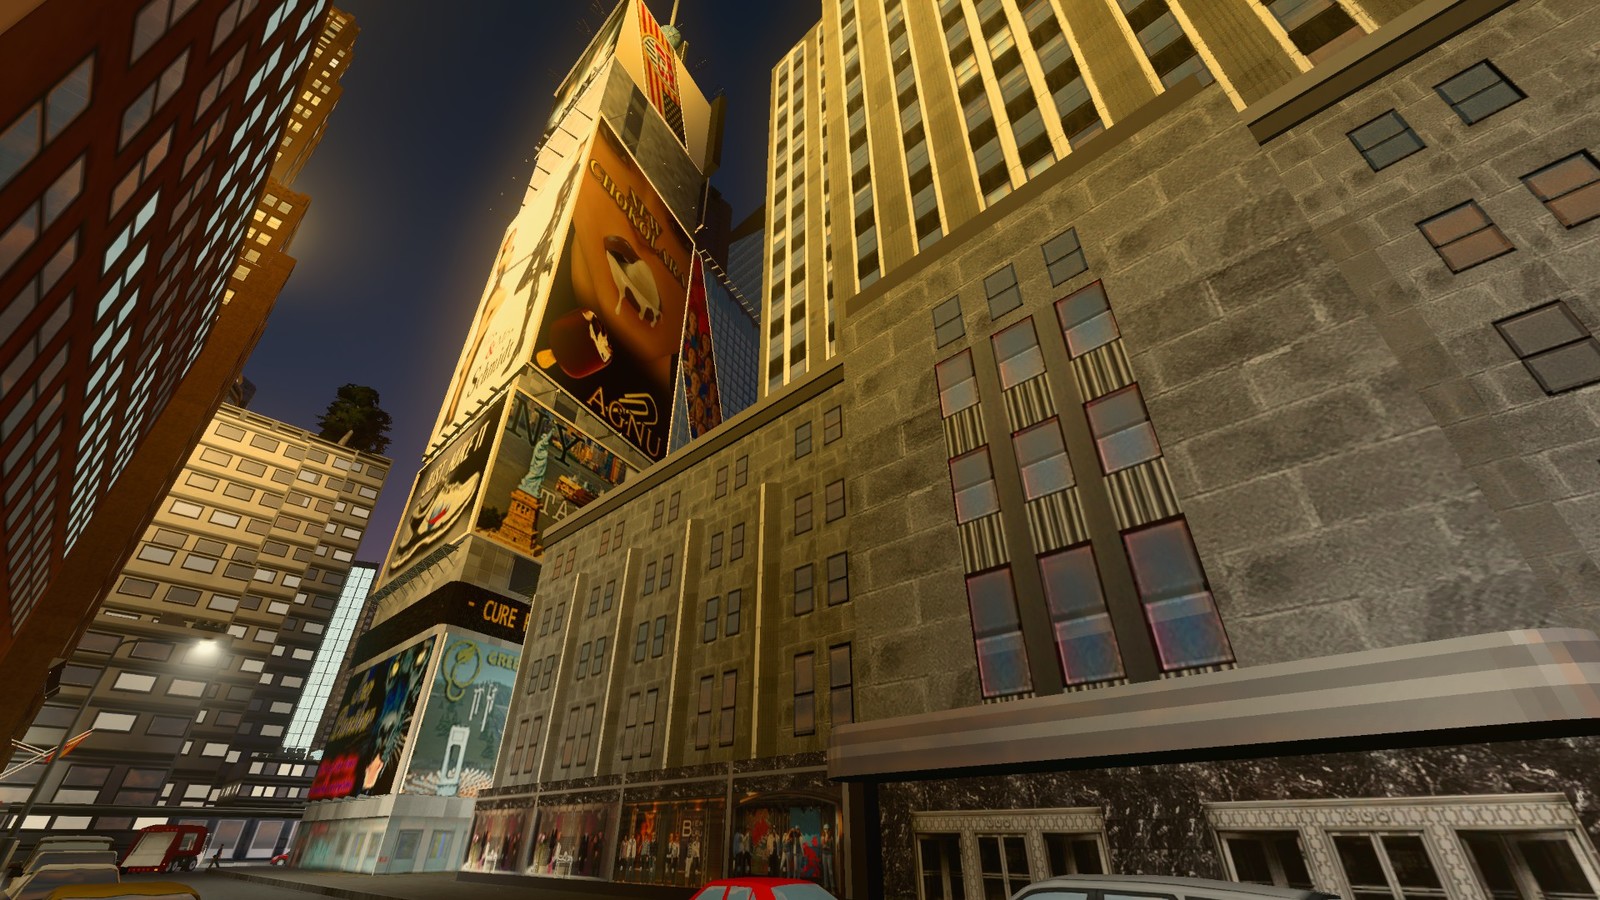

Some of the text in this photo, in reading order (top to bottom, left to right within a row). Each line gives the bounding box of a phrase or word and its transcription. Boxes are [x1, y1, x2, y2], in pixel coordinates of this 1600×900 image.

[628, 186, 663, 237] NEW
[474, 420, 490, 452] IT
[482, 600, 518, 629] CURE
